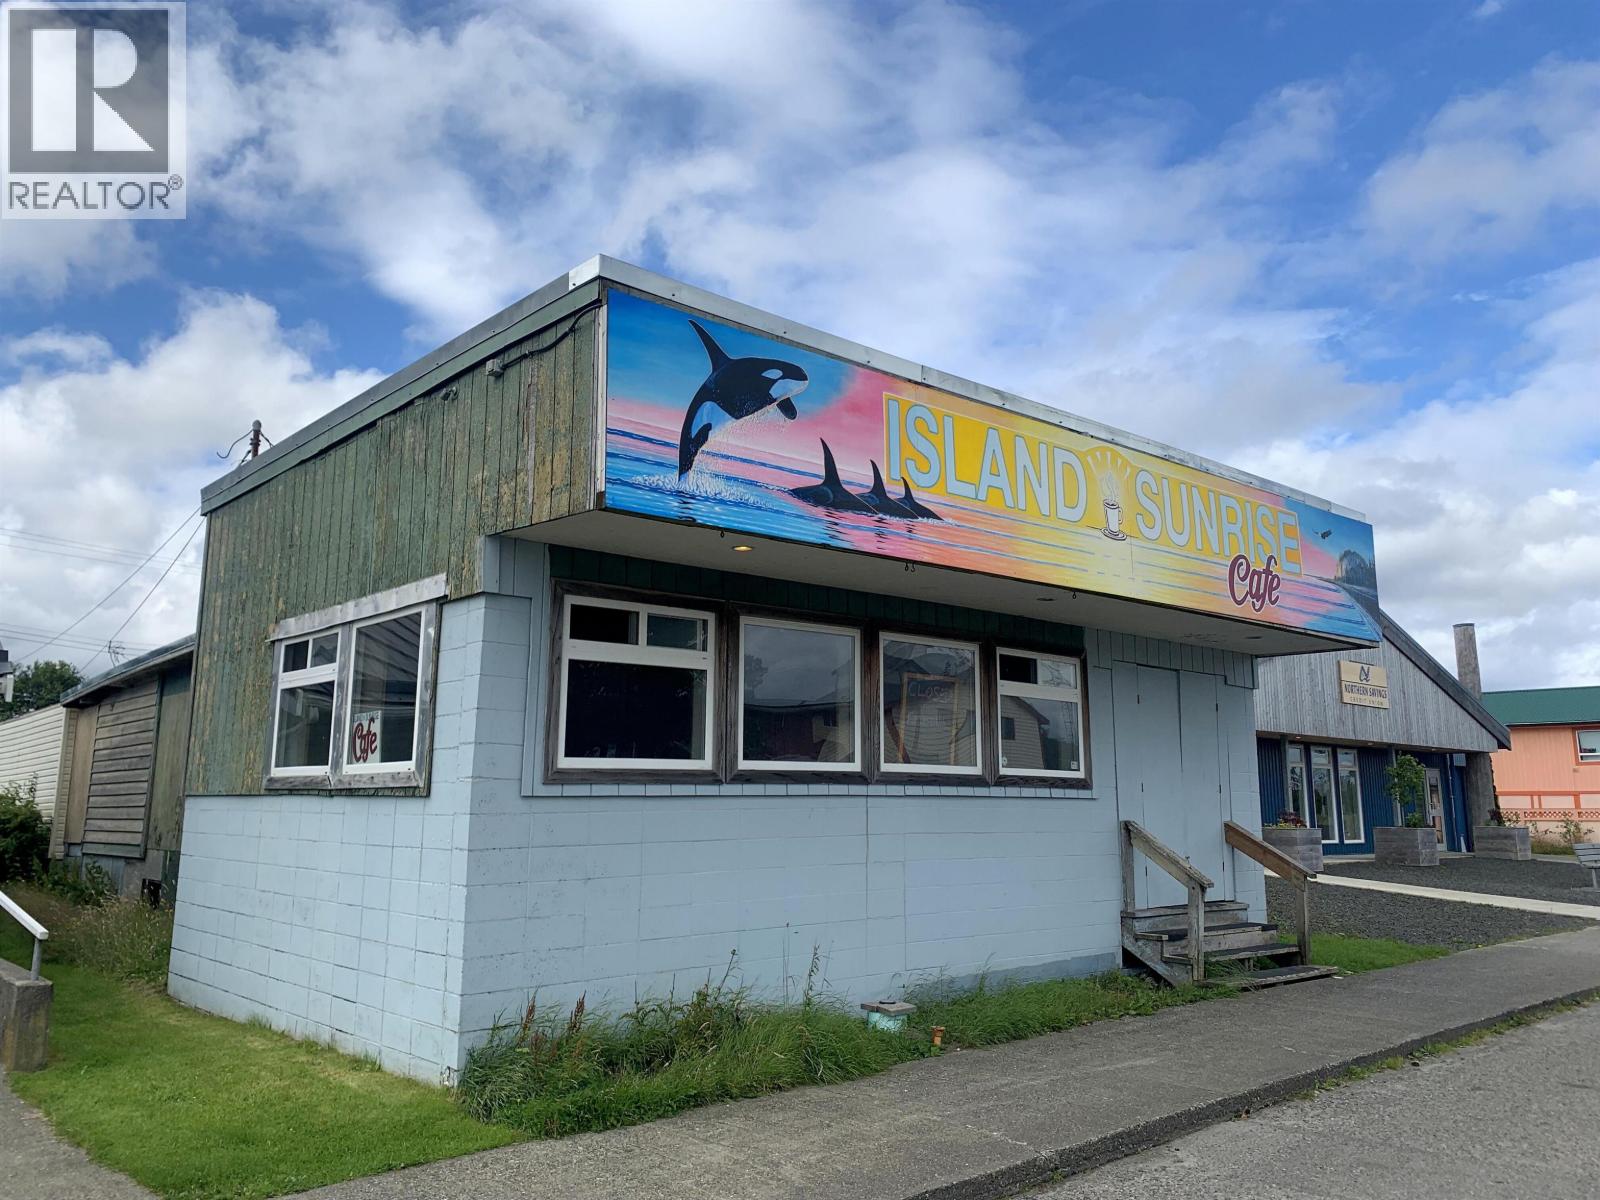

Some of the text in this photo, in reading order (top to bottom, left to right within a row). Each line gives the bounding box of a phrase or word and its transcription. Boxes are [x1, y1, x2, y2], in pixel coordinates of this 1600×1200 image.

[887, 398, 1302, 576] ISLAND SUNRISE
[1227, 553, 1281, 613] Cafe
[909, 682, 953, 698] CLOS
[1344, 684, 1387, 698] NORTHERN SAVINGS
[352, 717, 378, 763] Cafe
